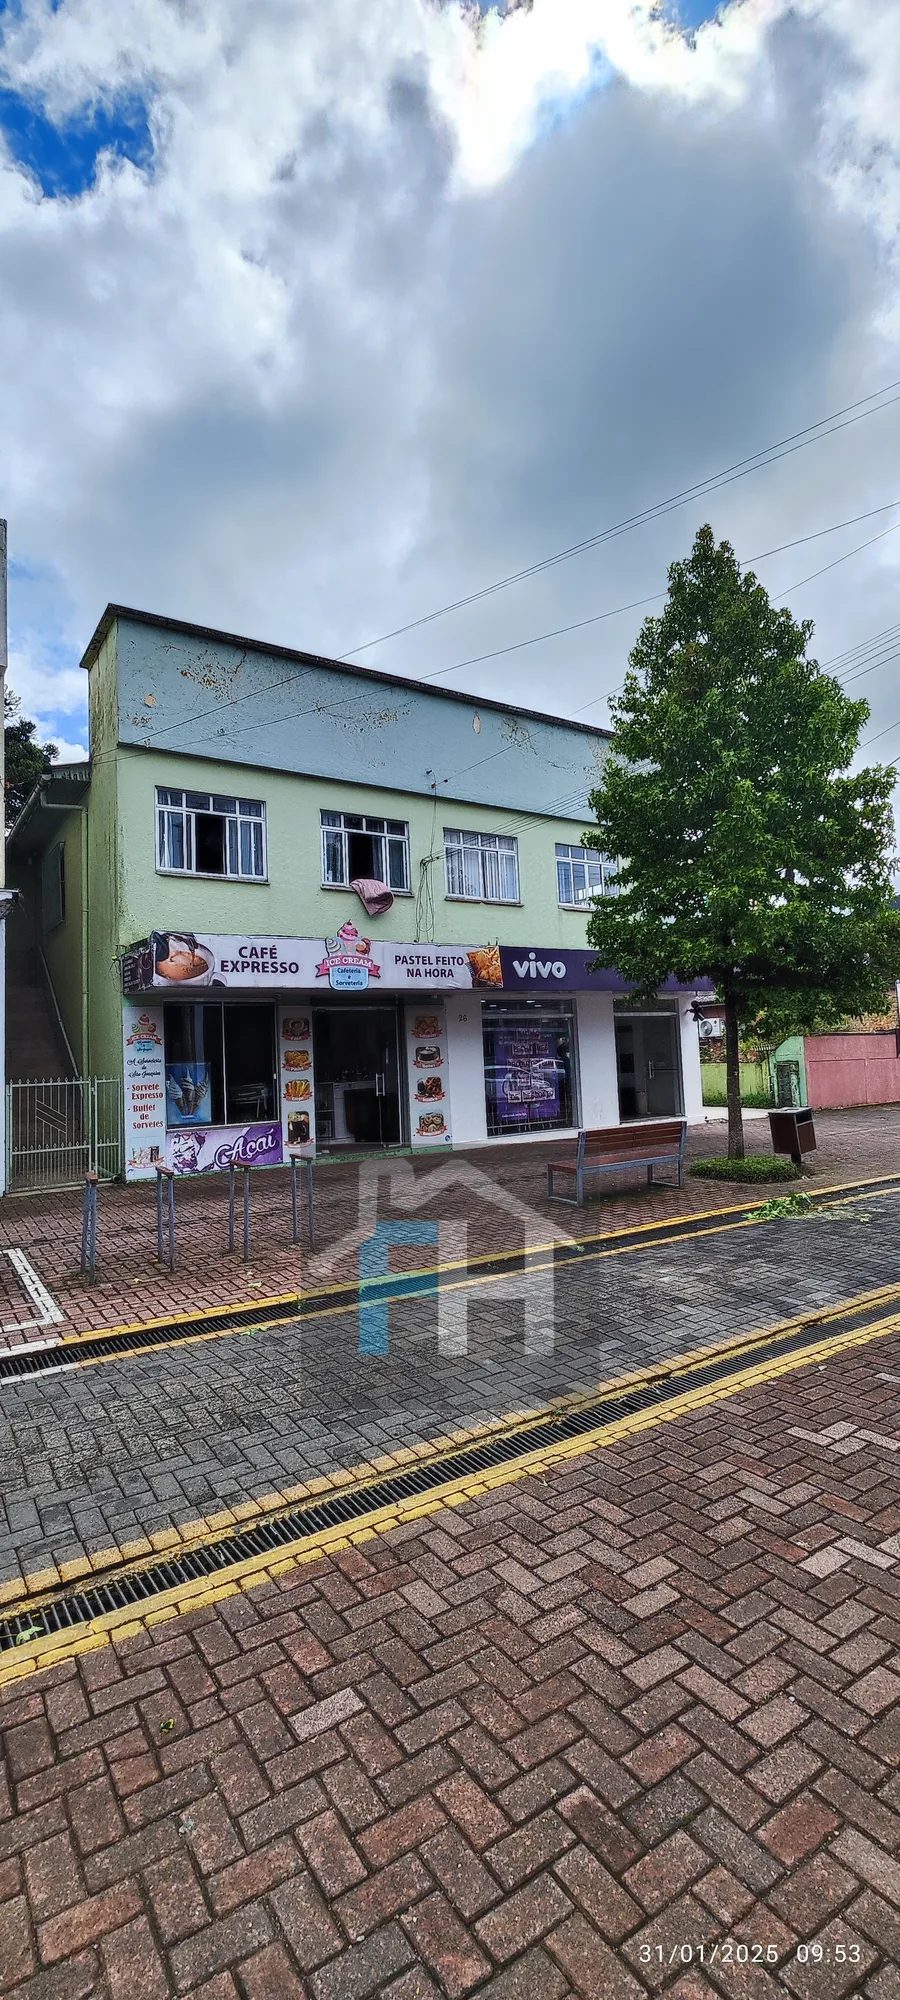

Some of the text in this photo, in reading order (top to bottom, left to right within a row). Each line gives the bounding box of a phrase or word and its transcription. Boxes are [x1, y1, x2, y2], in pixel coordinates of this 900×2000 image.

[238, 945, 278, 959] CAFÉ
[326, 957, 372, 968] ICE CREAM
[394, 955, 464, 966] PASTEL FEITO
[512, 952, 567, 979] vivo
[220, 960, 299, 974] EXPRESSO
[406, 968, 454, 978] NA HORA
[131, 1092, 164, 1100] Expresso
[133, 1104, 156, 1112] Buffet
[132, 1121, 164, 1130] Sorvetes
[215, 1128, 277, 1167] Açaí
